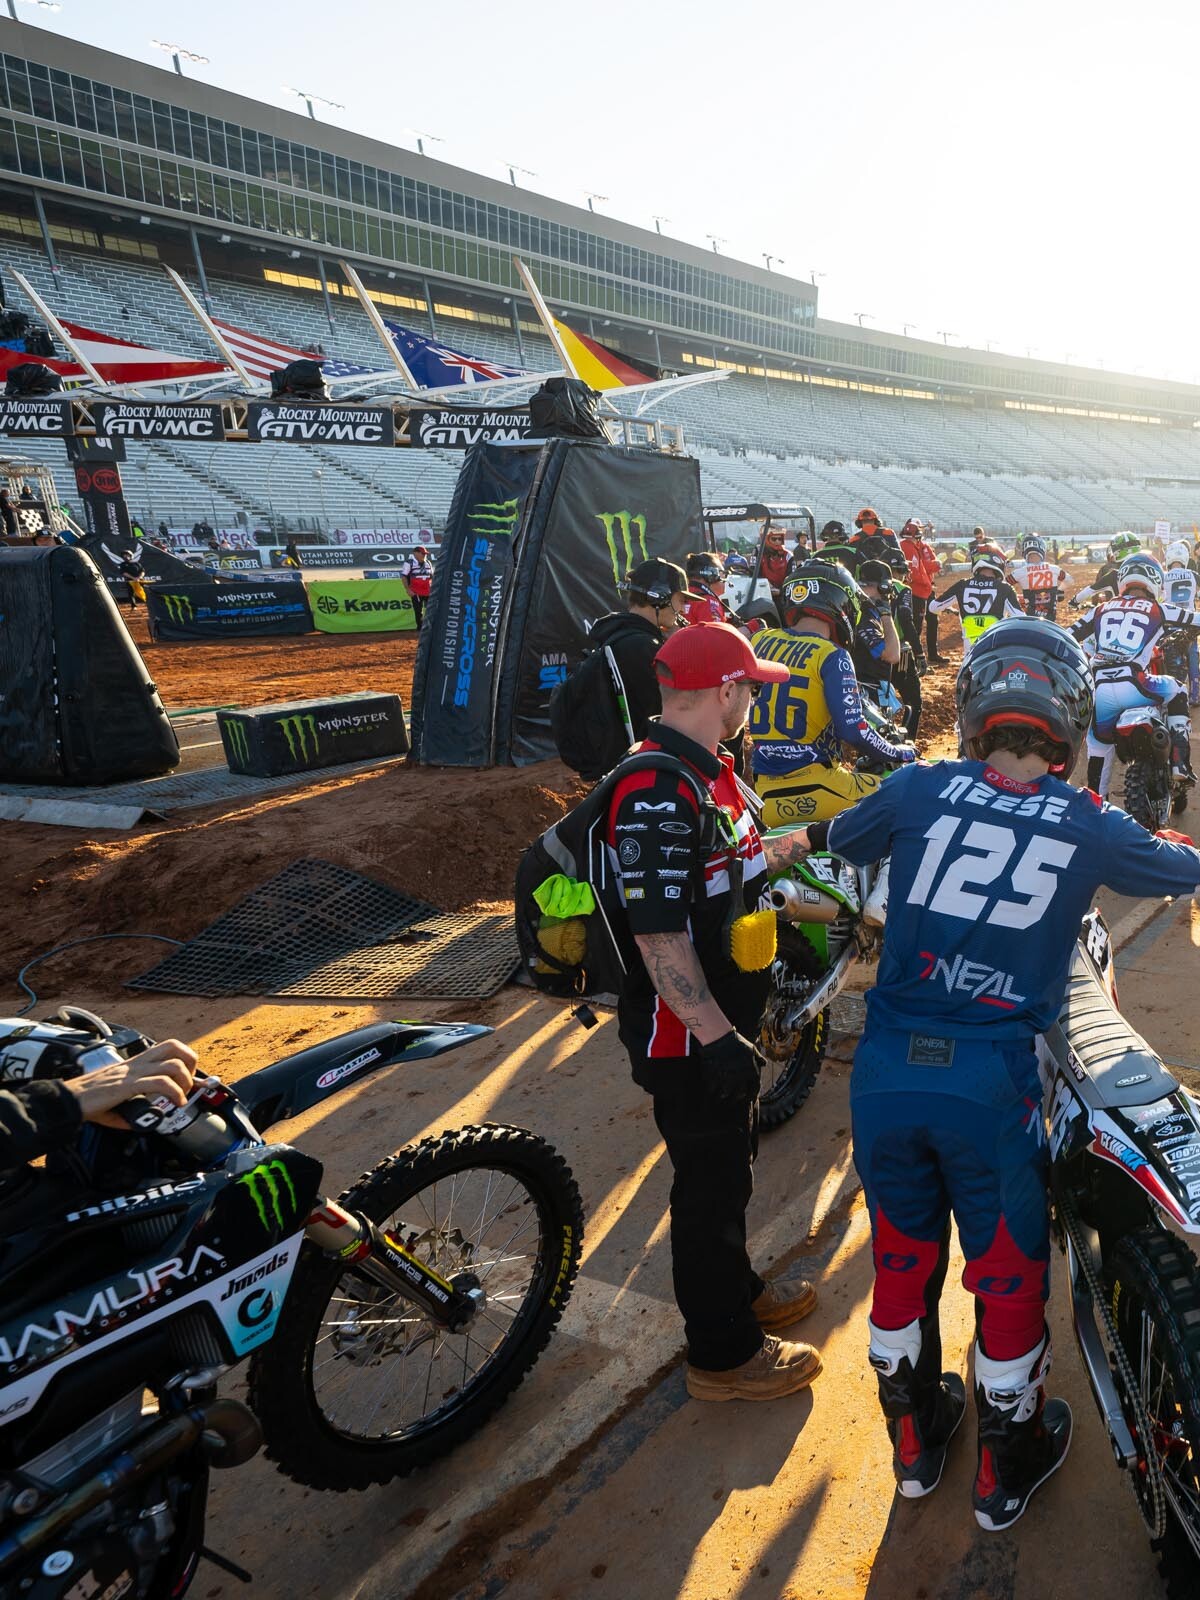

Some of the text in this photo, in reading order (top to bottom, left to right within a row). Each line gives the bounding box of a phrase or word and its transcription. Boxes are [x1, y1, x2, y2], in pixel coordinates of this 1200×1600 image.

[7, 401, 62, 414] MOUNTAIN
[119, 405, 212, 418] ROCKY MOUNTAIN
[277, 406, 383, 423] ROCKY MOUNTAIN
[439, 411, 531, 427] ROCKY MOUNT
[353, 530, 414, 545] ambetter
[1026, 564, 1049, 572] VIALLE
[1027, 571, 1053, 590] 128
[1165, 573, 1192, 581] MARTIN
[217, 591, 277, 602] MONSTER
[1170, 580, 1193, 603] 6
[344, 598, 412, 612] Kawas
[962, 588, 998, 614] 57
[1100, 600, 1154, 613] MILLER
[197, 603, 305, 618] SUPERCROSS
[221, 615, 285, 625] CHAMPIONSHIP
[442, 570, 463, 669] CHAMPIONSHIP
[454, 538, 488, 708] SUPERCROSS
[485, 575, 503, 667] MONSTER
[1099, 611, 1150, 649] 66
[541, 653, 568, 666] AMA
[1008, 672, 1028, 680] DOT
[318, 711, 390, 731] MONSTER
[938, 775, 1070, 824] NEESE
[906, 815, 1078, 930] 125
[804, 890, 820, 902] HGS
[335, 1050, 378, 1076] MAXIMA
[1067, 1053, 1085, 1080] GUTS
[1118, 1074, 1147, 1085] GUTS
[1100, 1131, 1149, 1171] CLUBMX
[1170, 1145, 1200, 1159] 100%
[549, 1225, 572, 1307] PIRELLI
